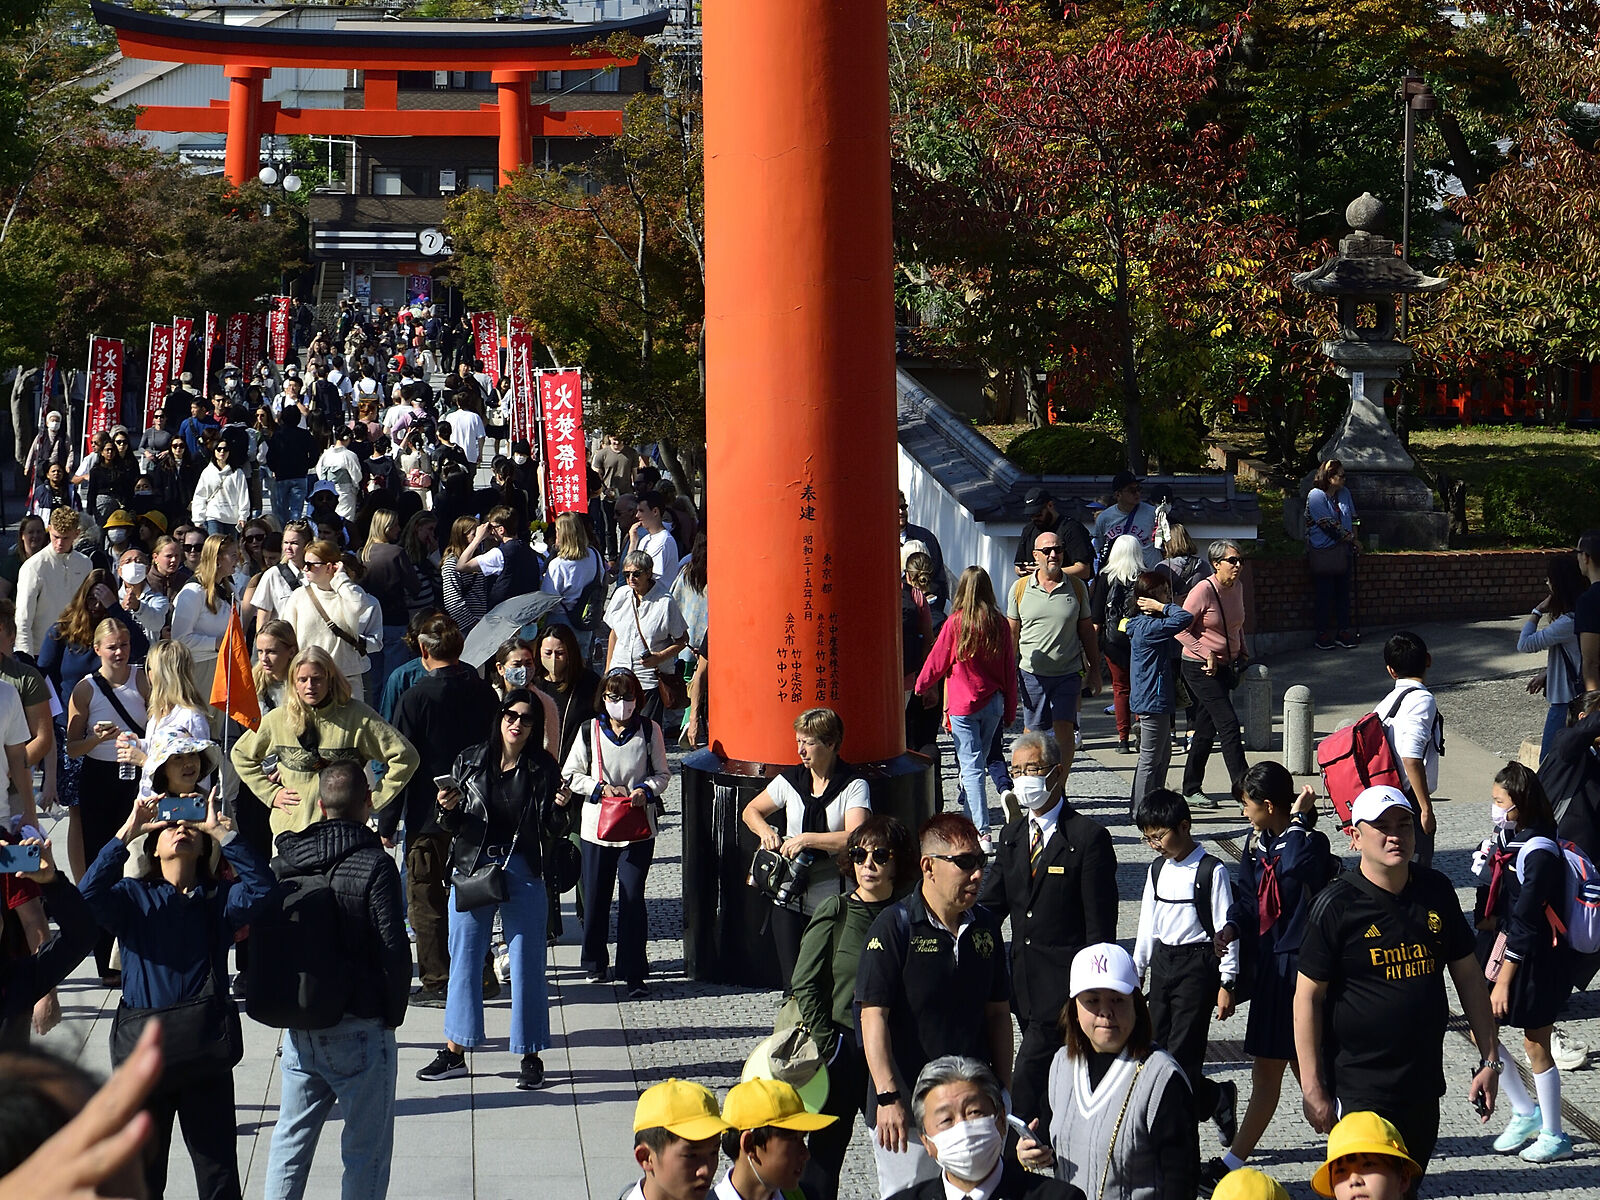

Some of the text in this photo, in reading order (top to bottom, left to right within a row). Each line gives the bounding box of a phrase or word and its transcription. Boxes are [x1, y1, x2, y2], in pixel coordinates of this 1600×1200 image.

[99, 348, 118, 410] 火焚祭
[552, 383, 578, 472] 火焚祭
[798, 484, 816, 521] 奉建
[802, 535, 814, 622] 昭和三十五年五月
[821, 553, 832, 594] 東京都
[784, 612, 796, 646] 金沢市
[776, 648, 788, 703] 竹中ツヤ
[790, 648, 802, 704] 竹中定次郎
[816, 649, 826, 702] 竹中商店
[1386, 958, 1436, 981] FLY BETTER
